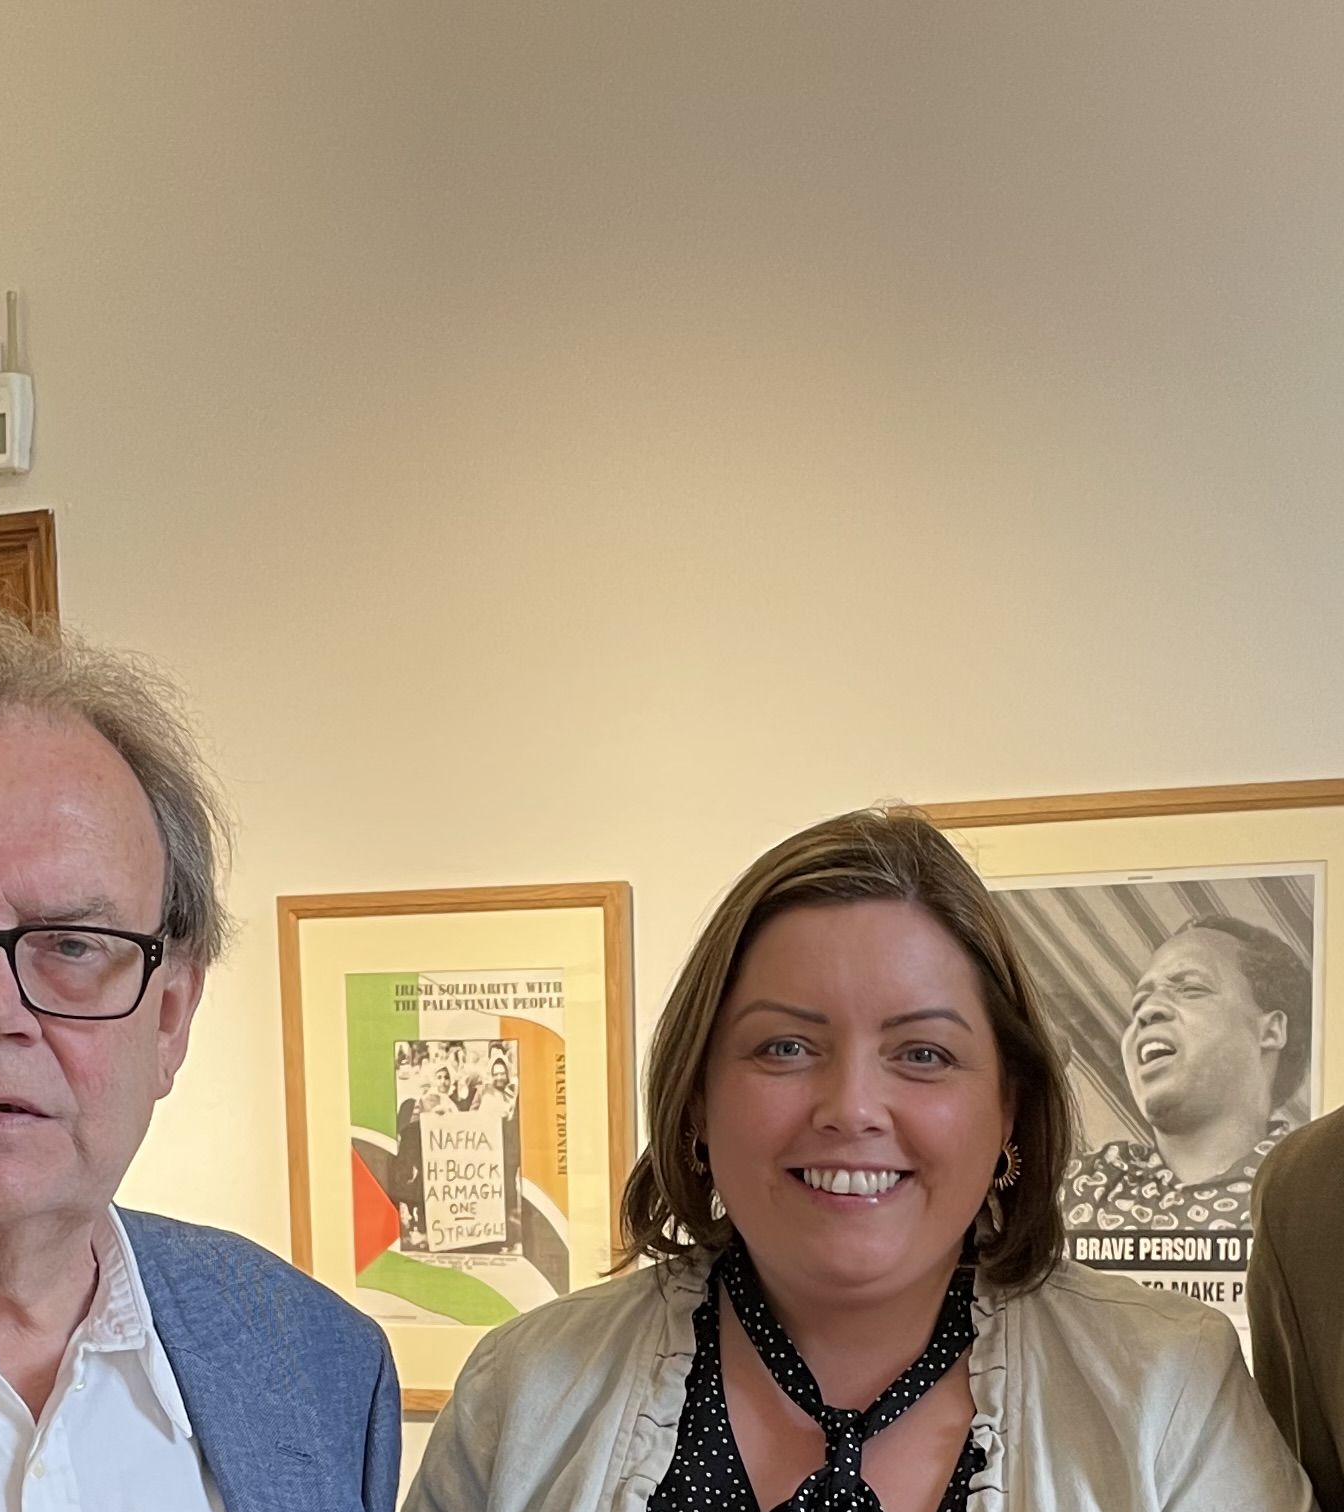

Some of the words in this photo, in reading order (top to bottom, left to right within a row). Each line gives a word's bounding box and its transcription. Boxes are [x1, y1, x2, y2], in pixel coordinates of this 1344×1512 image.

[394, 984, 433, 997] IRISH
[438, 982, 519, 996] SOLIDARITY
[526, 981, 563, 994] WITH
[393, 999, 418, 1012] THE
[423, 997, 509, 1012] PALESTINIAN
[512, 996, 565, 1010] PEOPLE
[555, 1053, 566, 1106] SMASH
[429, 1129, 493, 1151] NAFHA
[427, 1159, 501, 1182] H-BLOCK
[426, 1183, 502, 1202] ARMAGH
[449, 1202, 477, 1215] ONE
[431, 1219, 505, 1246] STRUGGLE
[1076, 1237, 1134, 1261] BRAVE
[1139, 1236, 1213, 1262] PERSON
[1216, 1236, 1241, 1262] TO
